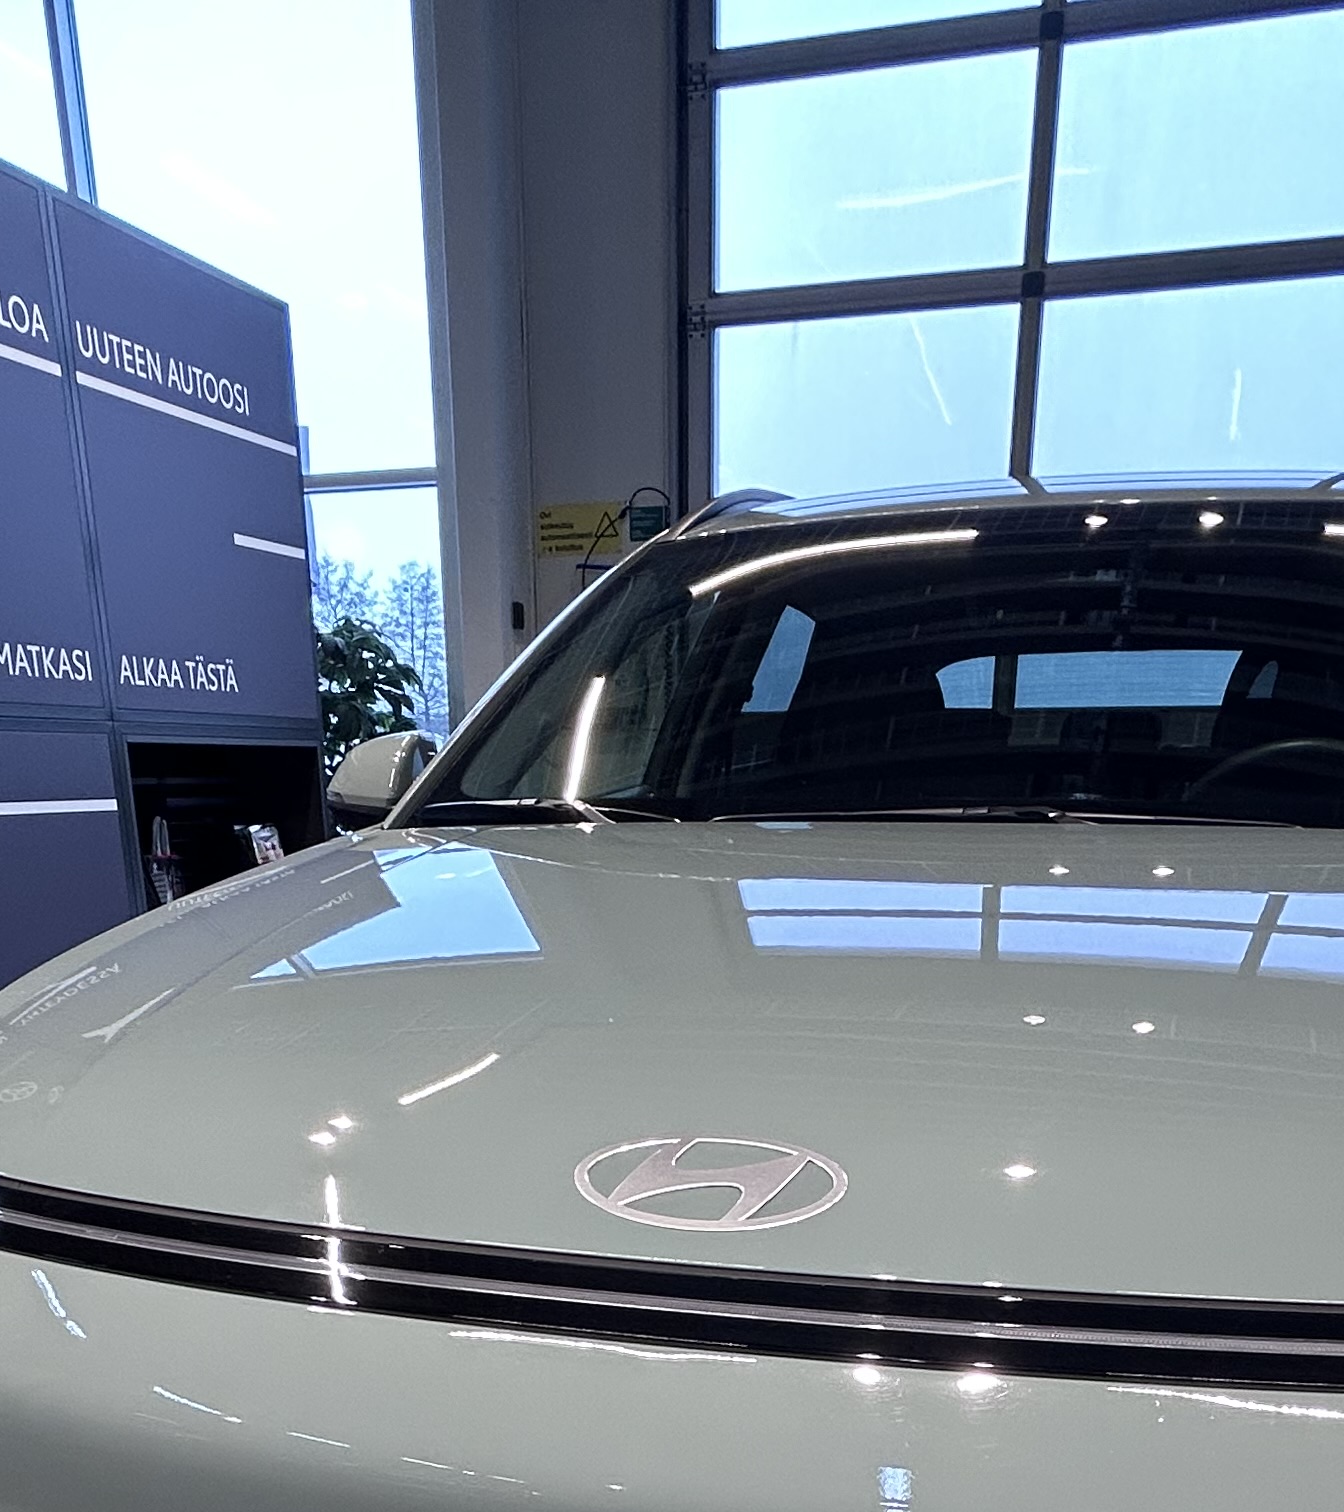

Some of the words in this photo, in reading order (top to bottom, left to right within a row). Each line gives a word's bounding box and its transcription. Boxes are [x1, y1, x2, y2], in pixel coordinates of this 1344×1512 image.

[75, 320, 163, 385] UUTEEN
[167, 357, 250, 417] AUTOOSI
[120, 654, 185, 689] ALKAA
[185, 655, 239, 693] TÄSTÄ
